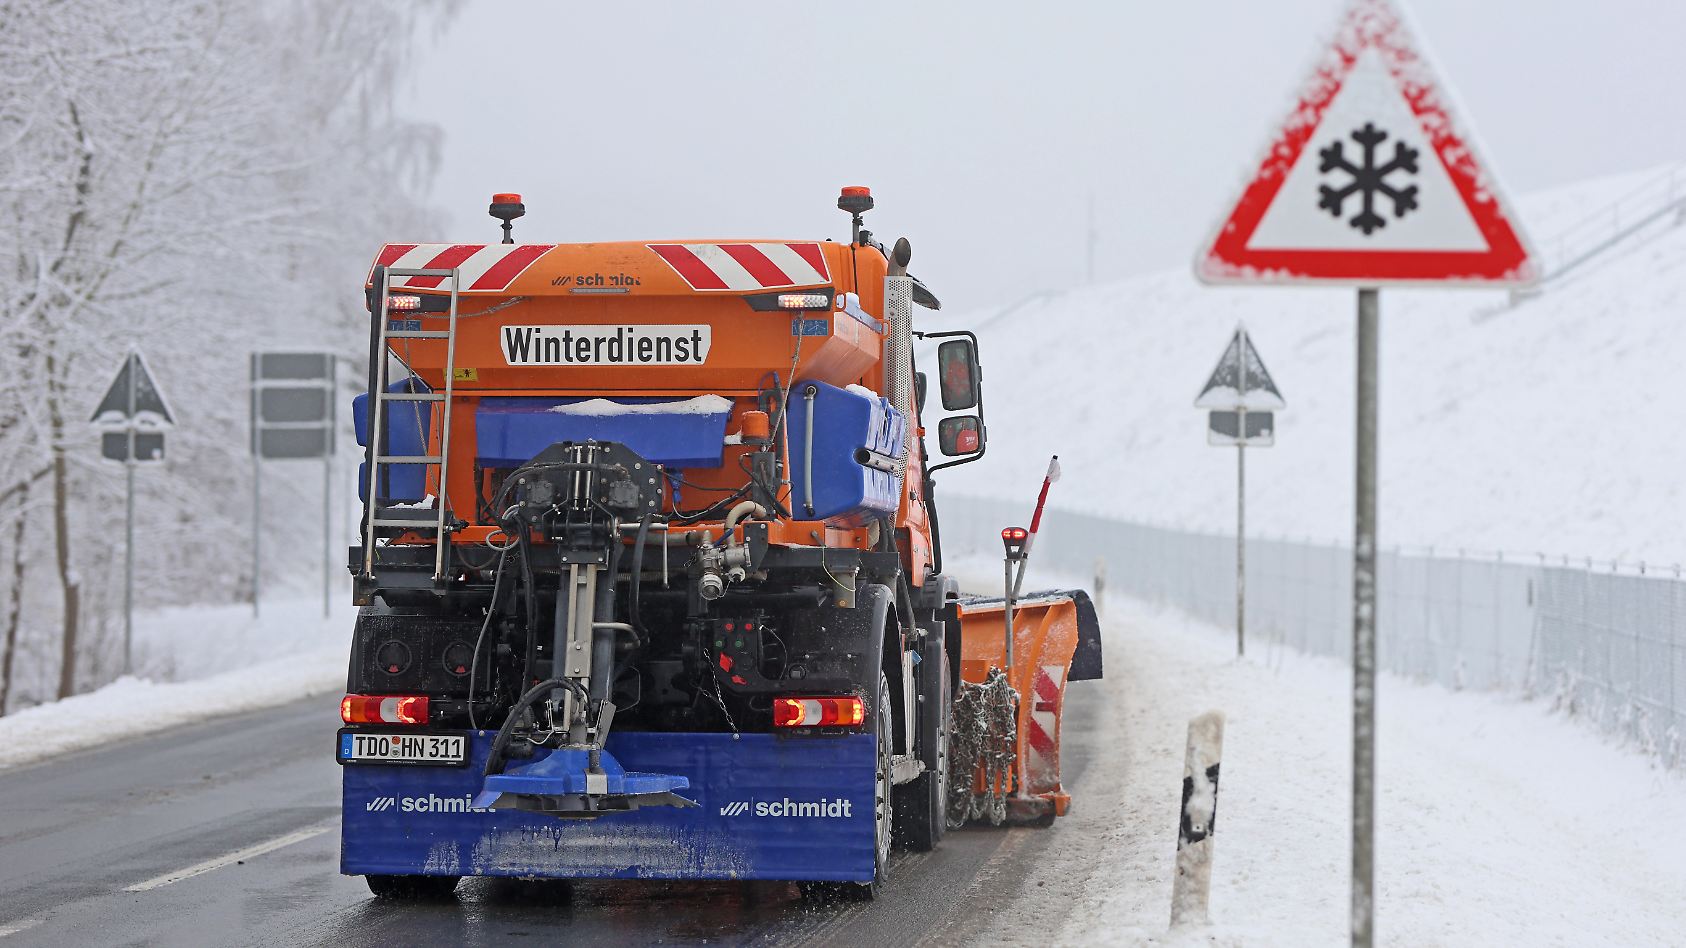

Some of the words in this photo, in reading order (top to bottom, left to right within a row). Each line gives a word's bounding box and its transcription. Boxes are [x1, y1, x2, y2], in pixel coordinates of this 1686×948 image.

[505, 327, 702, 363] Winterdienst
[356, 736, 389, 756] TDO
[402, 738, 424, 757] HN
[429, 738, 462, 758] 311
[402, 794, 496, 812] schmi
[756, 798, 852, 817] schmidt
